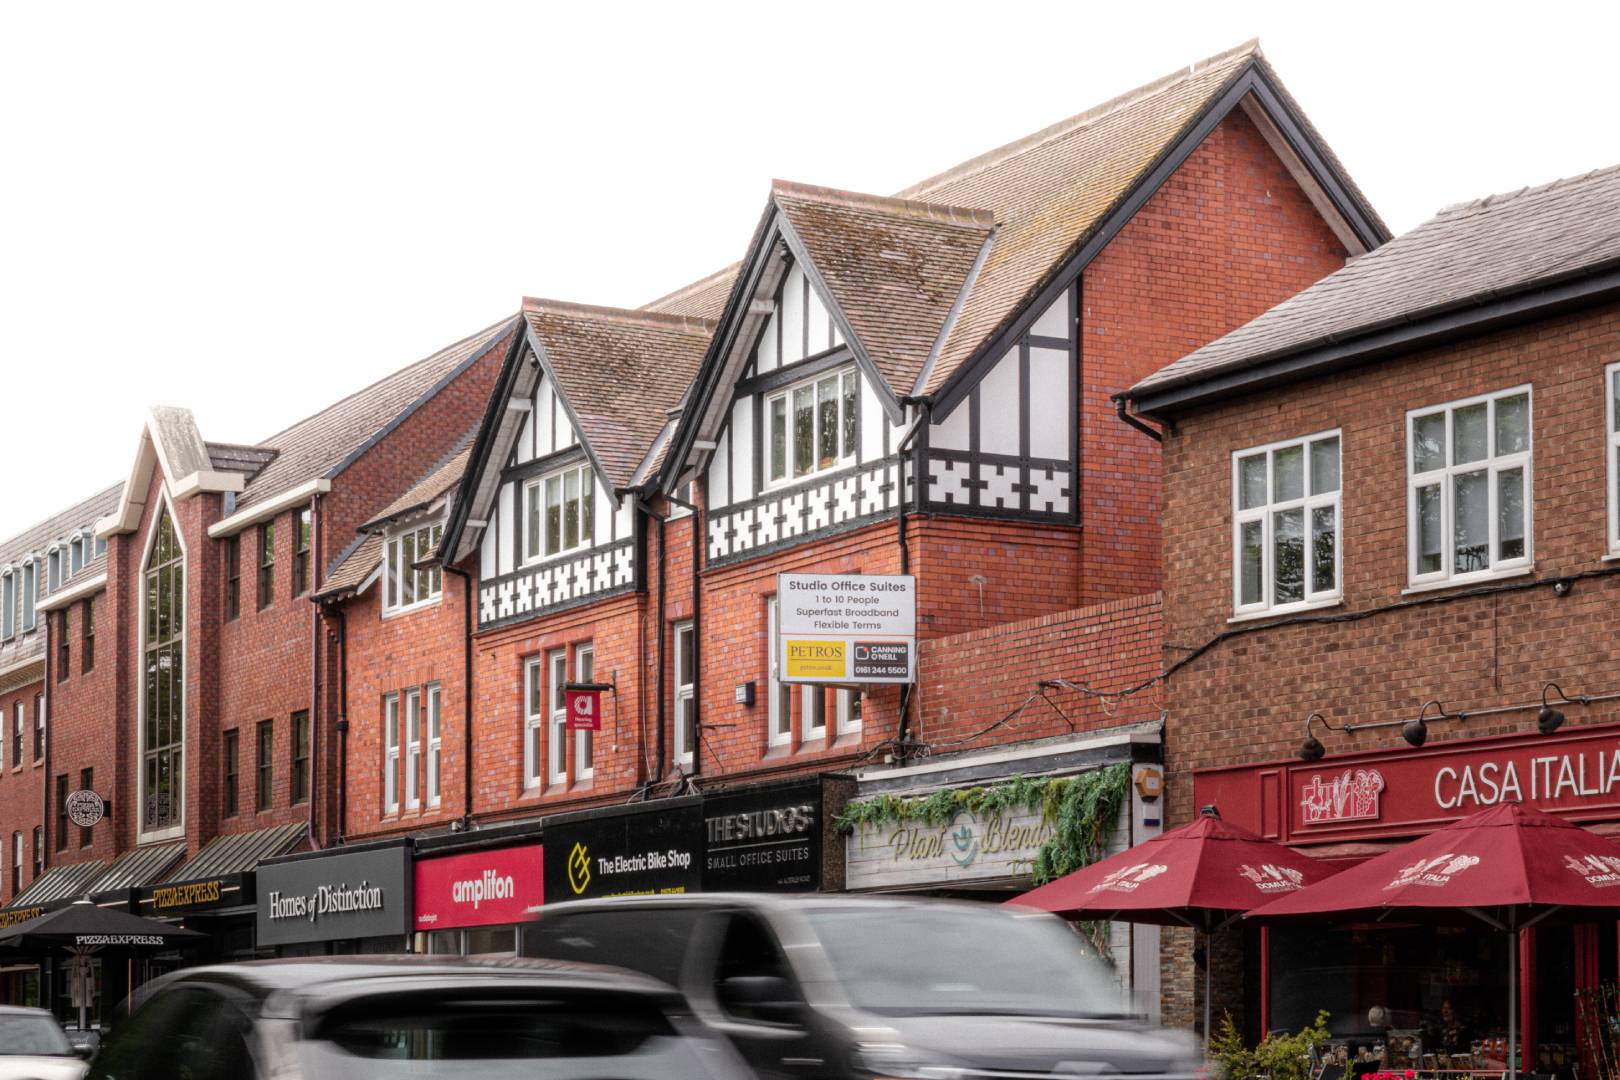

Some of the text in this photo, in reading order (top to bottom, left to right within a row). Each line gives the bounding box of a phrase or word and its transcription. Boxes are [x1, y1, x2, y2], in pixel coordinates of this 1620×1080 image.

[789, 580, 906, 592] Studio Office Suites
[815, 595, 880, 606] 1 to 10 People
[796, 607, 899, 618] Superfast Broadband
[814, 620, 882, 630] Flexible Terms
[790, 645, 843, 658] PETROS
[871, 646, 907, 654] CANNING
[871, 666, 887, 674] 244
[887, 666, 907, 674] 5500
[1434, 760, 1523, 809] CASA
[888, 815, 1054, 862] Plant Blends
[598, 849, 691, 875] The Electric Bike Shop
[707, 847, 809, 870] SMALL OFFICE SUITES
[152, 880, 220, 909] PIZZAEXPRESS
[452, 869, 514, 910] amplifon
[268, 880, 382, 922] Homes of Distinction
[75, 934, 164, 945] PIZZAEXPRESS
